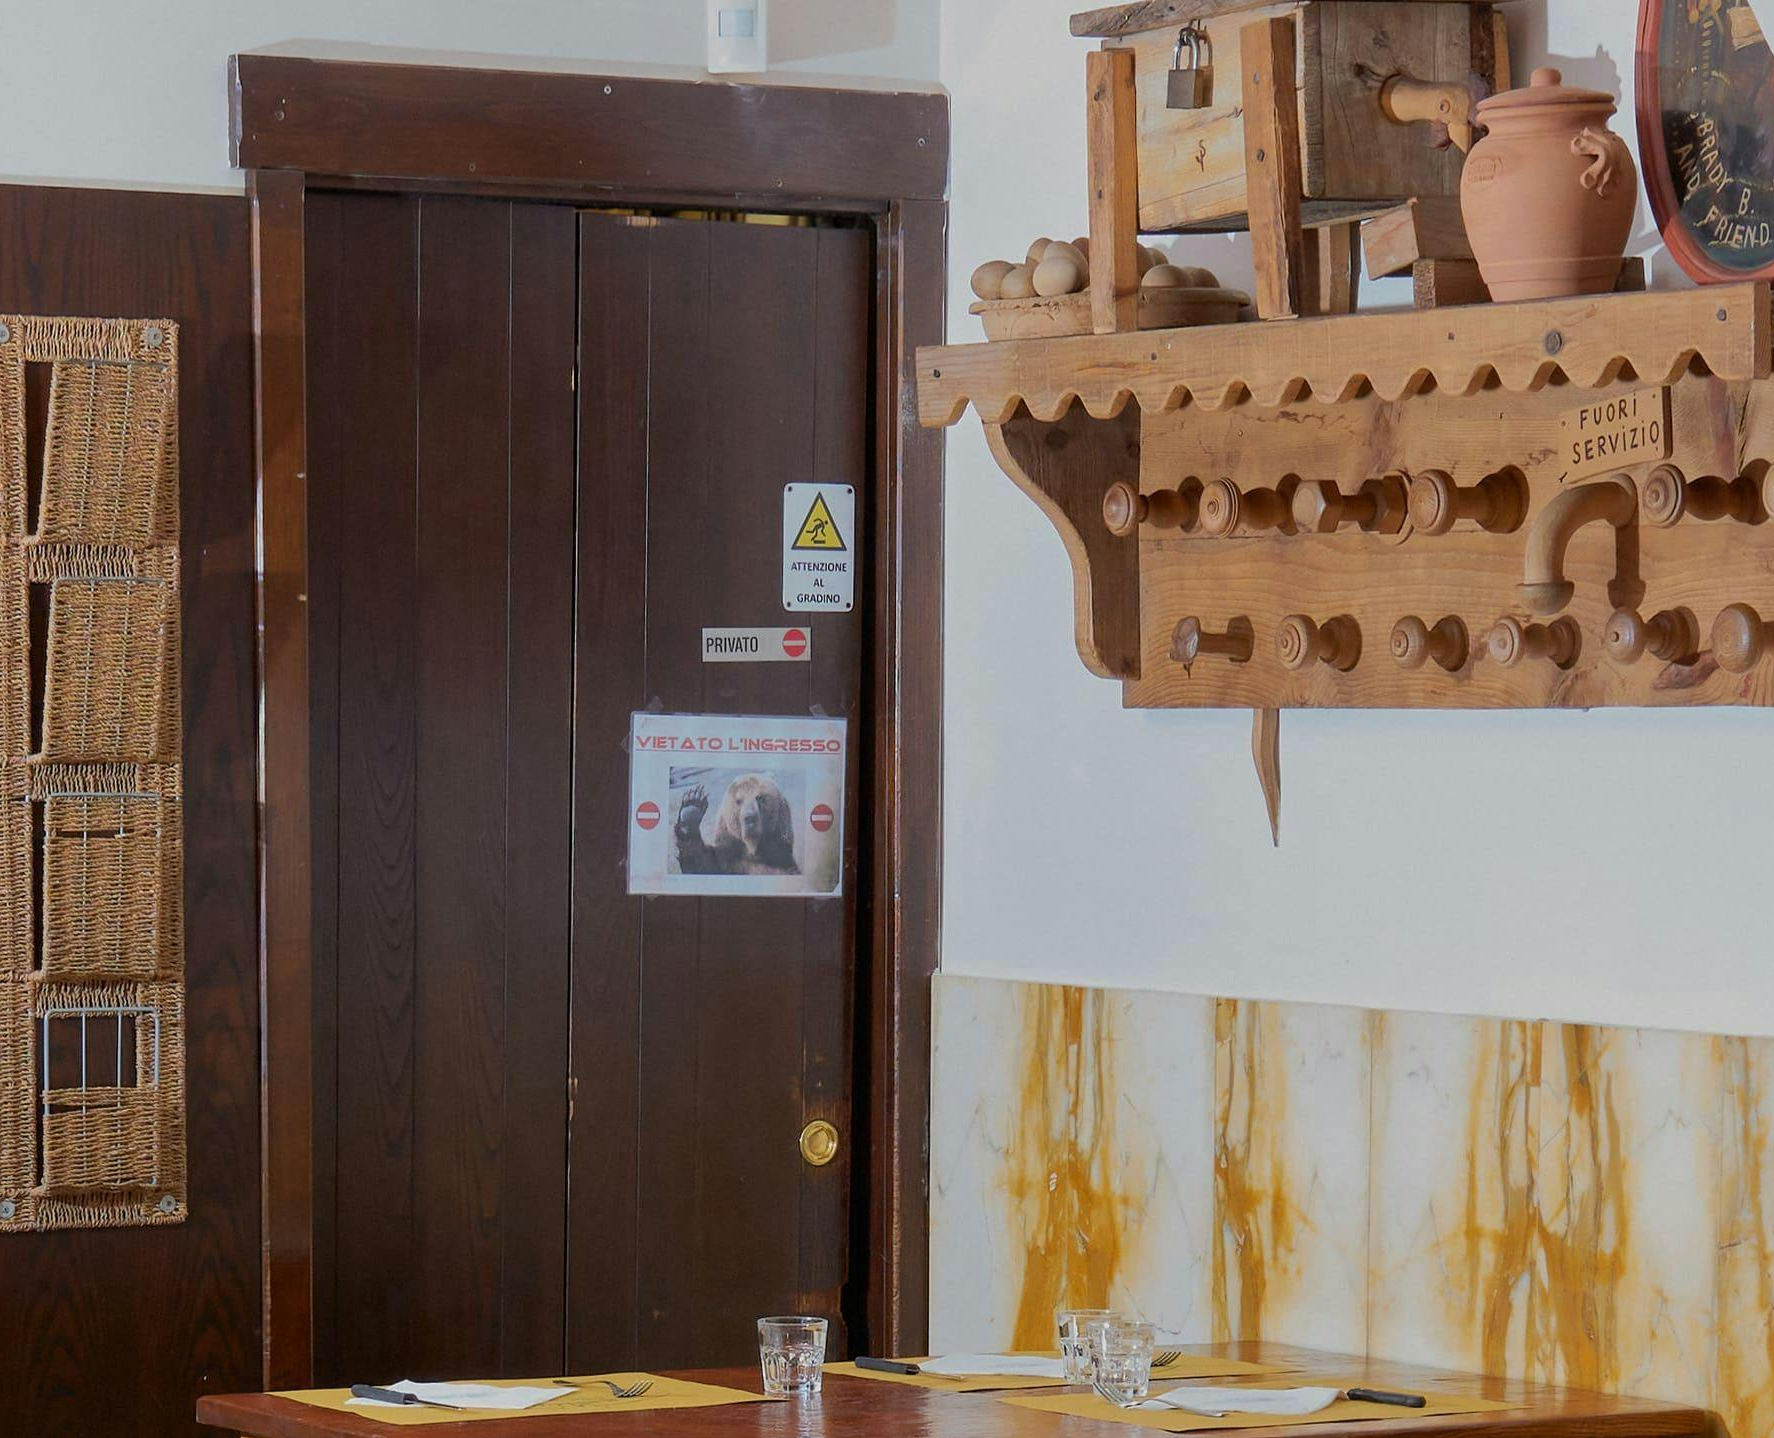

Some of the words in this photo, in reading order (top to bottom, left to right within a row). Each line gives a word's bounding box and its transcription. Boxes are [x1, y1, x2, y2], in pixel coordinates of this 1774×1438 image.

[1696, 118, 1734, 194] BRADY
[1675, 143, 1701, 193] AND
[790, 561, 848, 573] ATTENZIONE
[813, 578, 825, 588] AL
[796, 593, 841, 604] GRADINO
[706, 636, 759, 654] PRIVATO
[636, 735, 723, 750] VIETATO
[728, 737, 842, 752] L'INGRESSO
